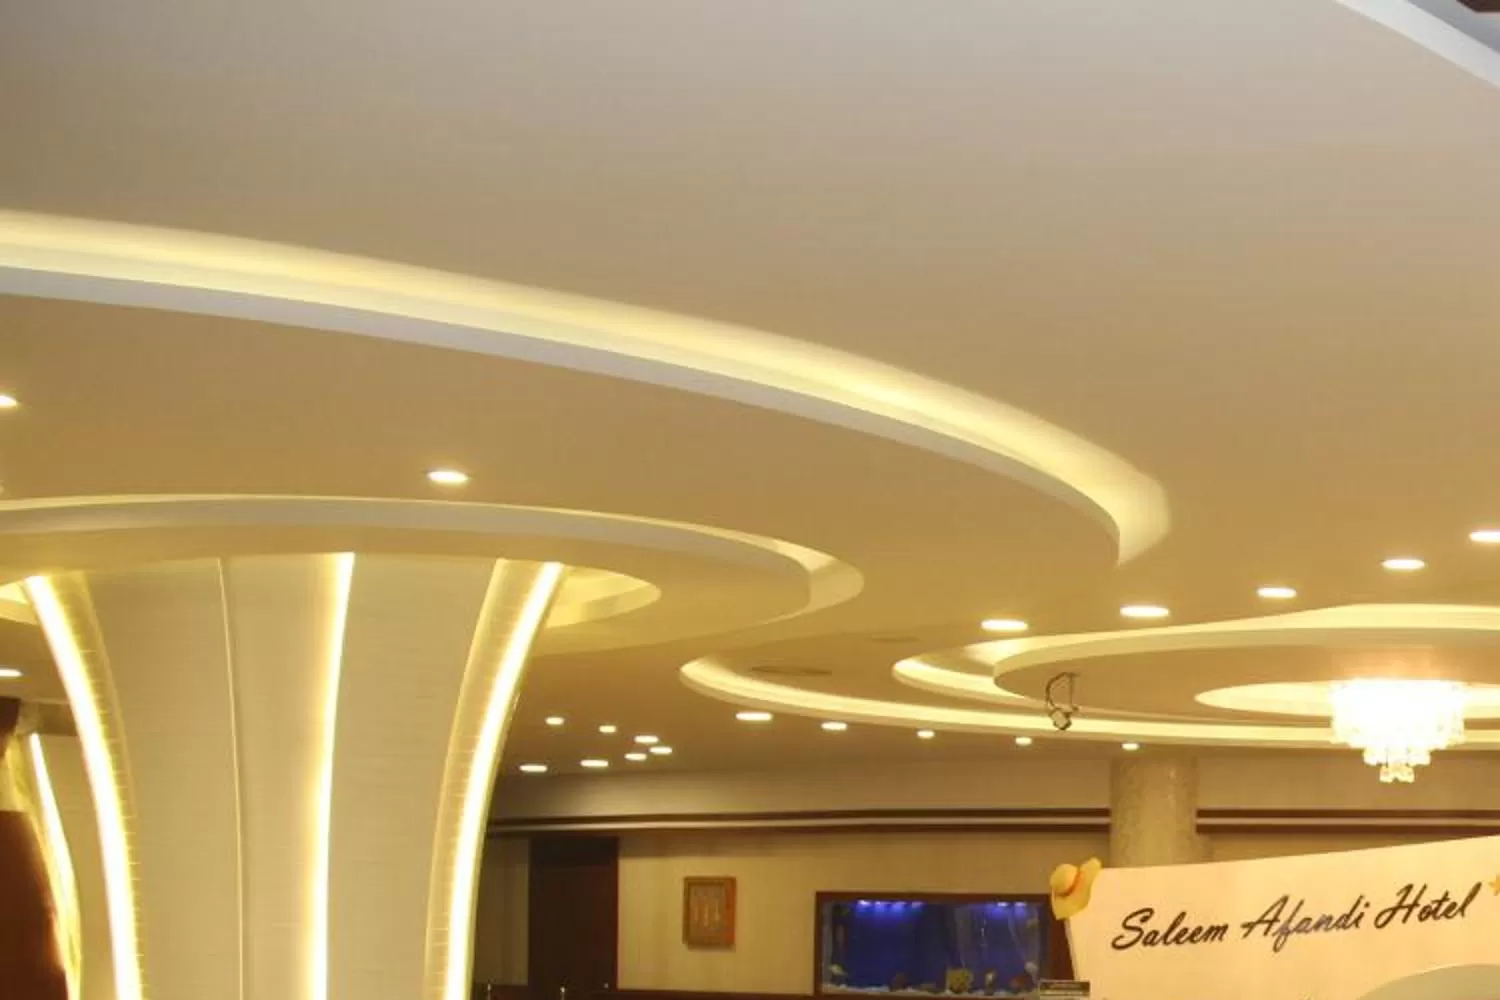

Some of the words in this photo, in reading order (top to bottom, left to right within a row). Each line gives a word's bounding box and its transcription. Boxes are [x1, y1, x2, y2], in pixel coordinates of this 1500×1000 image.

[1110, 906, 1229, 951] Saleem
[1240, 894, 1371, 953] Afandi
[1374, 881, 1483, 930] Hotel
